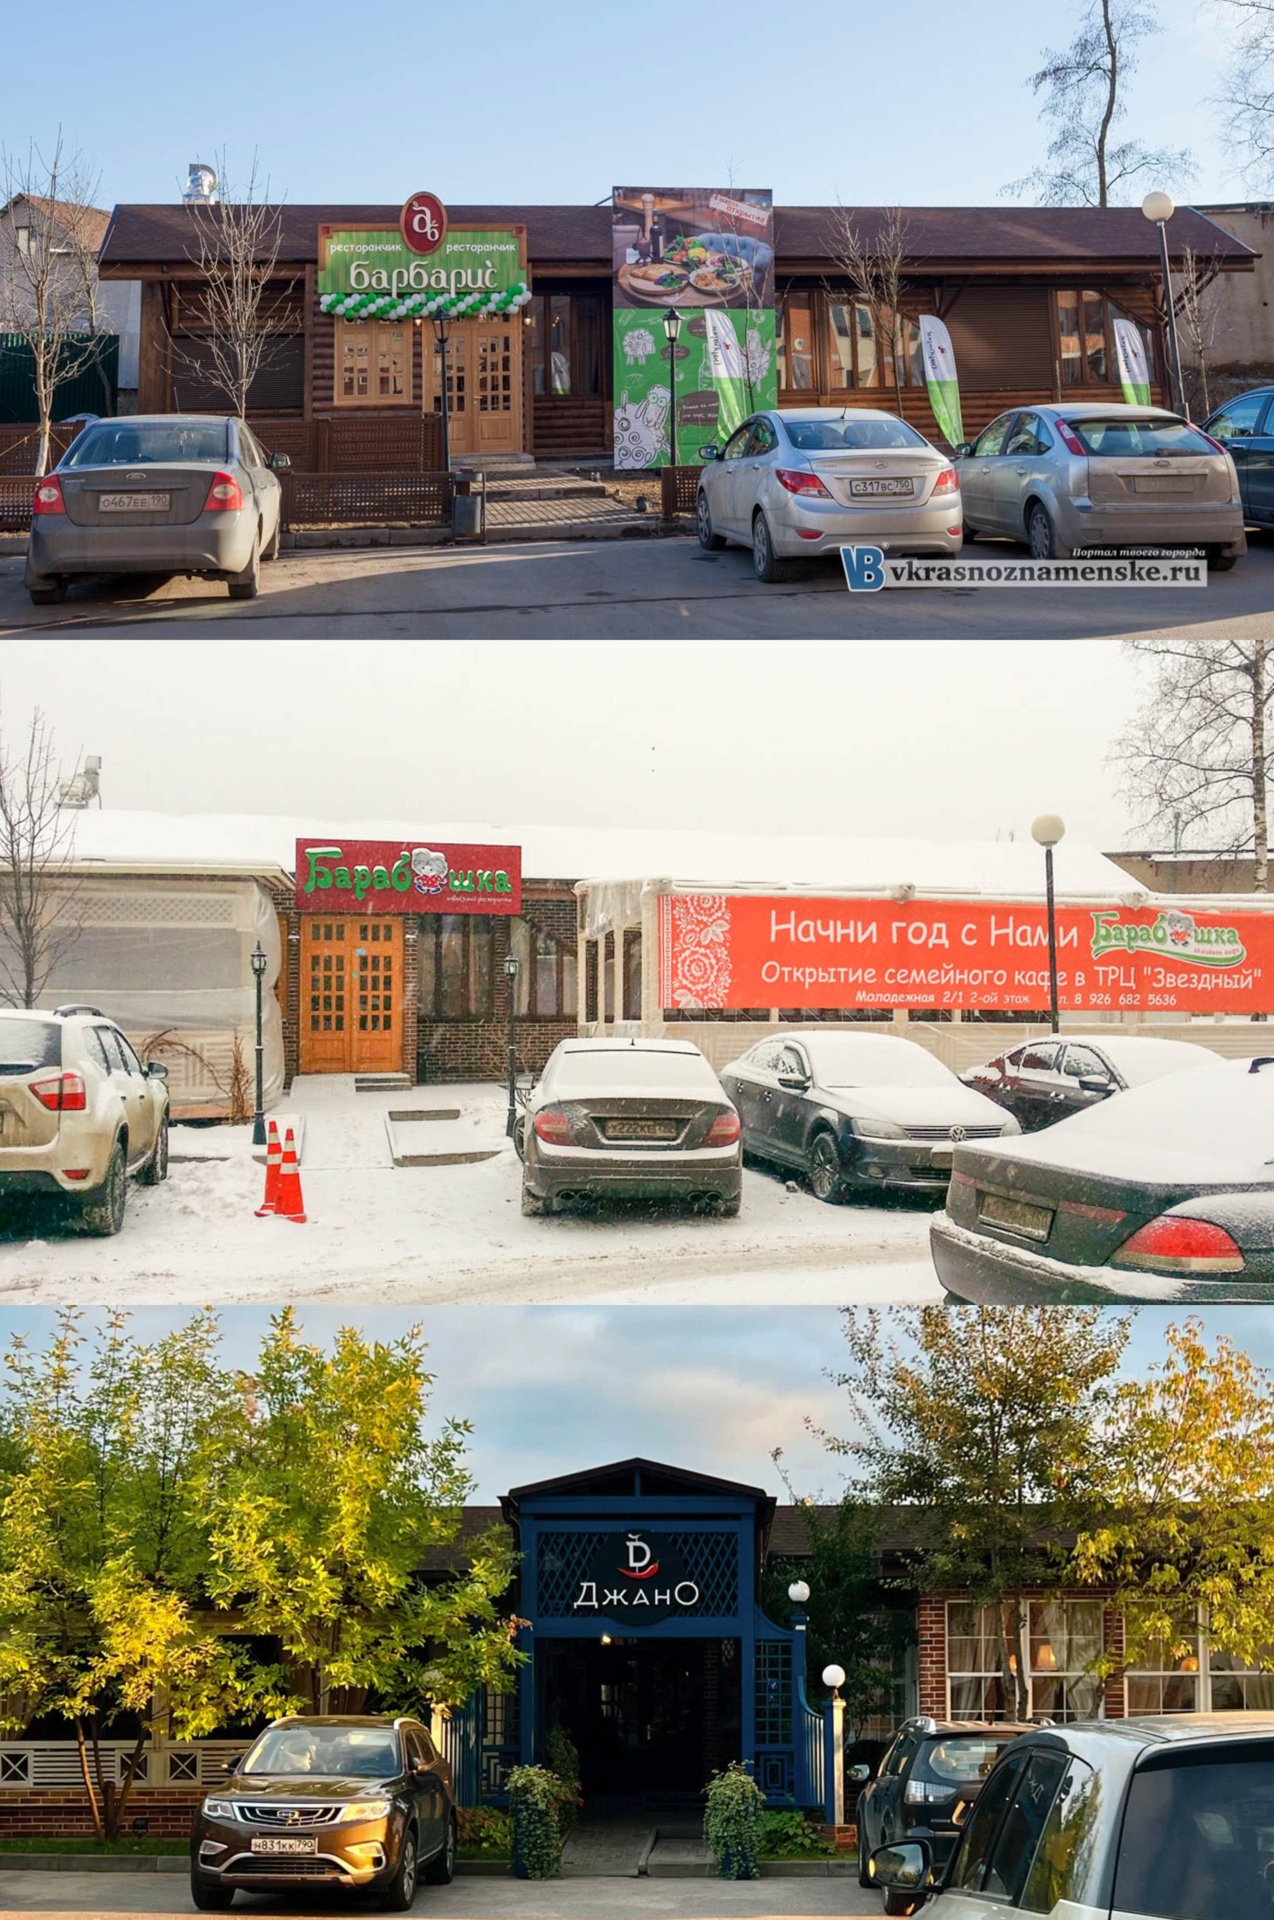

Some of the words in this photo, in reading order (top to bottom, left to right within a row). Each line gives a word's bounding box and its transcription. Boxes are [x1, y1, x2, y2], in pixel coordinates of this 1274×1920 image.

[330, 244, 402, 254] ресторанчик
[446, 244, 515, 254] ресторанчик
[350, 260, 498, 298] барбарис
[770, 909, 878, 943] Начни
[891, 921, 949, 949] год
[960, 923, 978, 946] с
[990, 915, 1078, 948] Нами
[761, 961, 878, 989] Открытие
[884, 963, 1007, 986] семейного
[1014, 970, 1068, 992] кафе
[1075, 971, 1086, 987] в
[1093, 966, 1136, 990] ТРЦ
[1143, 966, 1262, 991] "Звездный"
[855, 990, 935, 1003] Молодежная
[942, 990, 963, 1003] 2/1
[969, 991, 998, 1004] 2-ой
[1004, 994, 1030, 1004] этаж
[1074, 993, 1083, 1005] 8
[1089, 993, 1111, 1005] 926
[1118, 993, 1141, 1005] 682
[1148, 993, 1177, 1006] 5636
